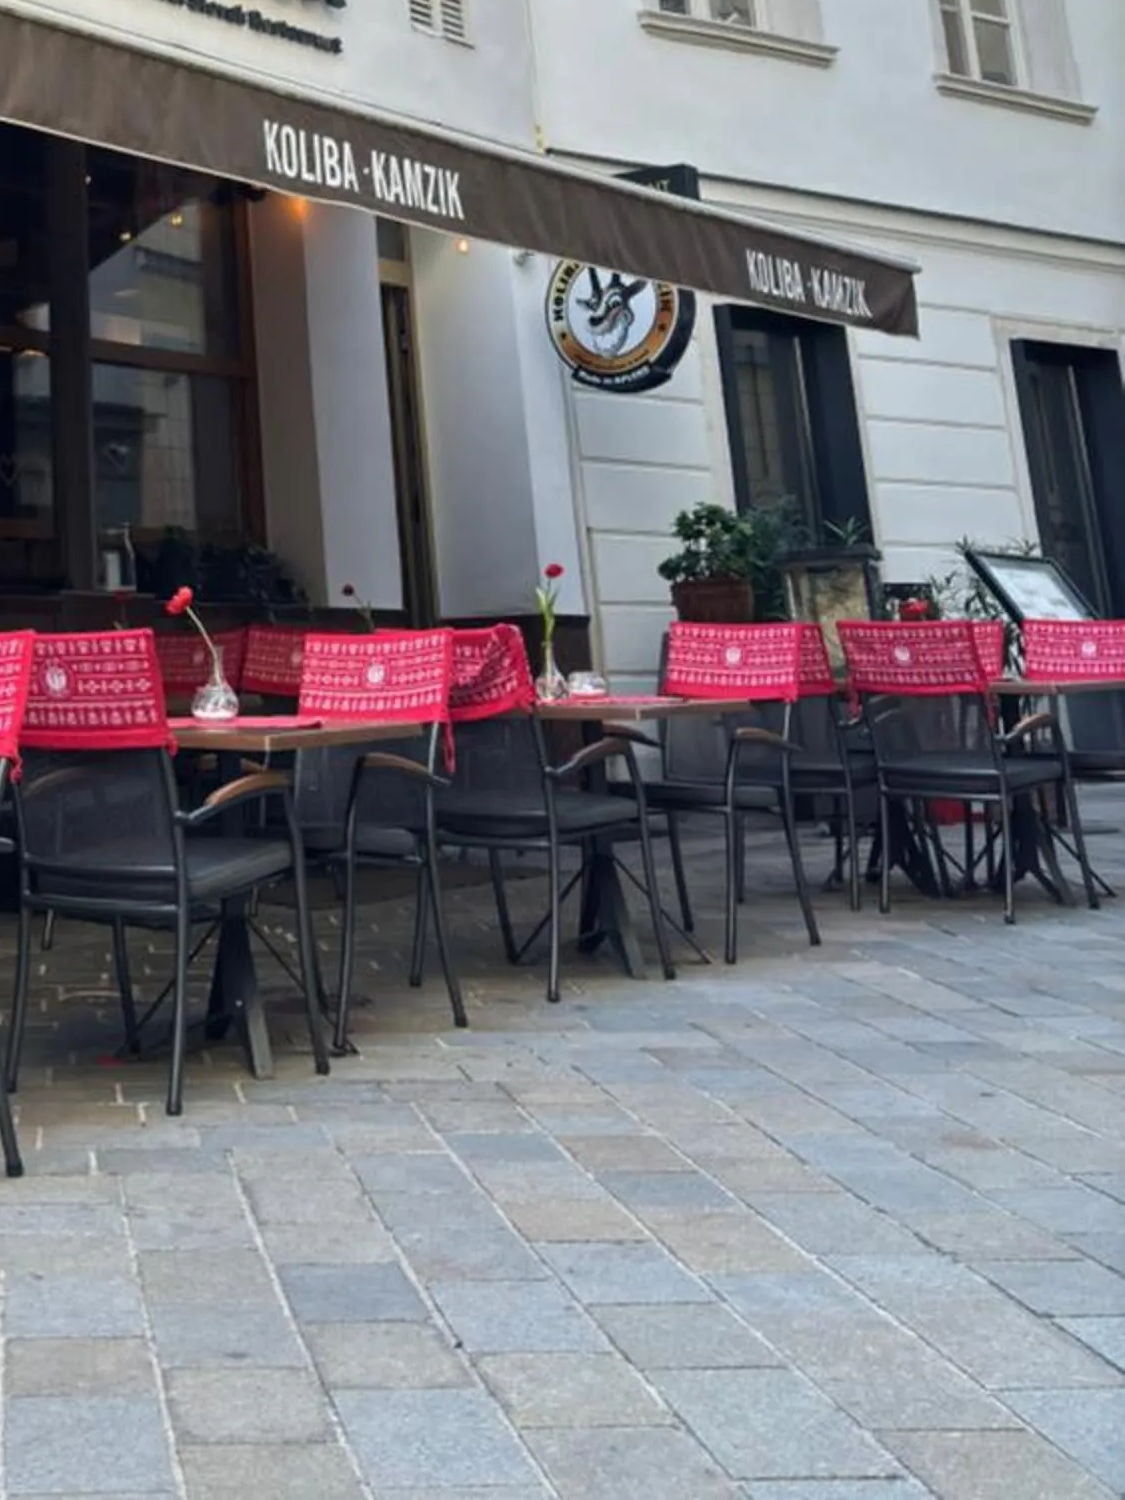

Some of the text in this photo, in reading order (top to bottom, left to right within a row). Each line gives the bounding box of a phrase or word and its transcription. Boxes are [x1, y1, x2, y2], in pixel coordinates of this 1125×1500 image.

[262, 118, 465, 221] KOLIBA KAMZIK
[745, 248, 874, 319] KOLIBA KAMZIK
